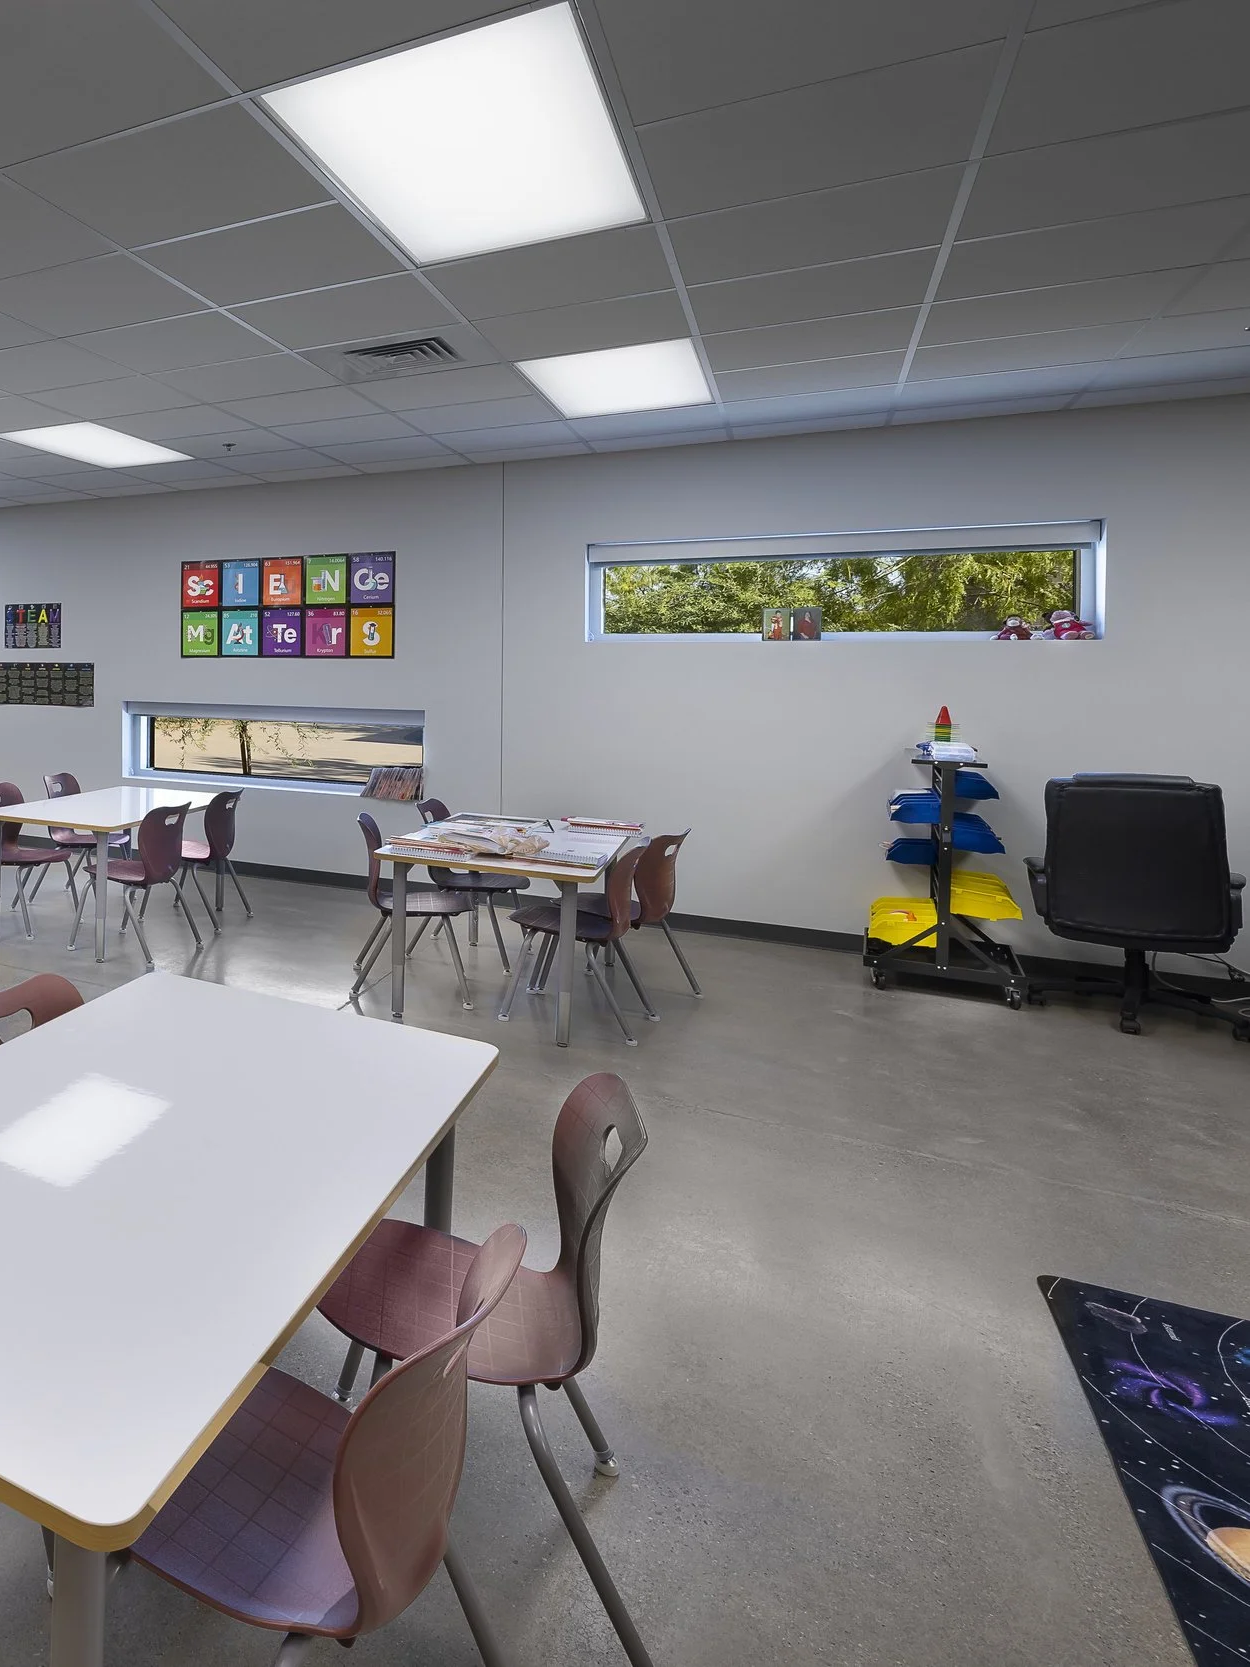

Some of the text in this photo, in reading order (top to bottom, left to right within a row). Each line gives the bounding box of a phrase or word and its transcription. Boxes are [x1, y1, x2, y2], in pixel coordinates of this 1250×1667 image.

[187, 575, 214, 597] Sc
[238, 573, 243, 594] I
[354, 568, 390, 591] Ce
[187, 624, 214, 645] Mg
[226, 623, 253, 645] At
[273, 623, 297, 643] Te
[362, 621, 381, 646] S
